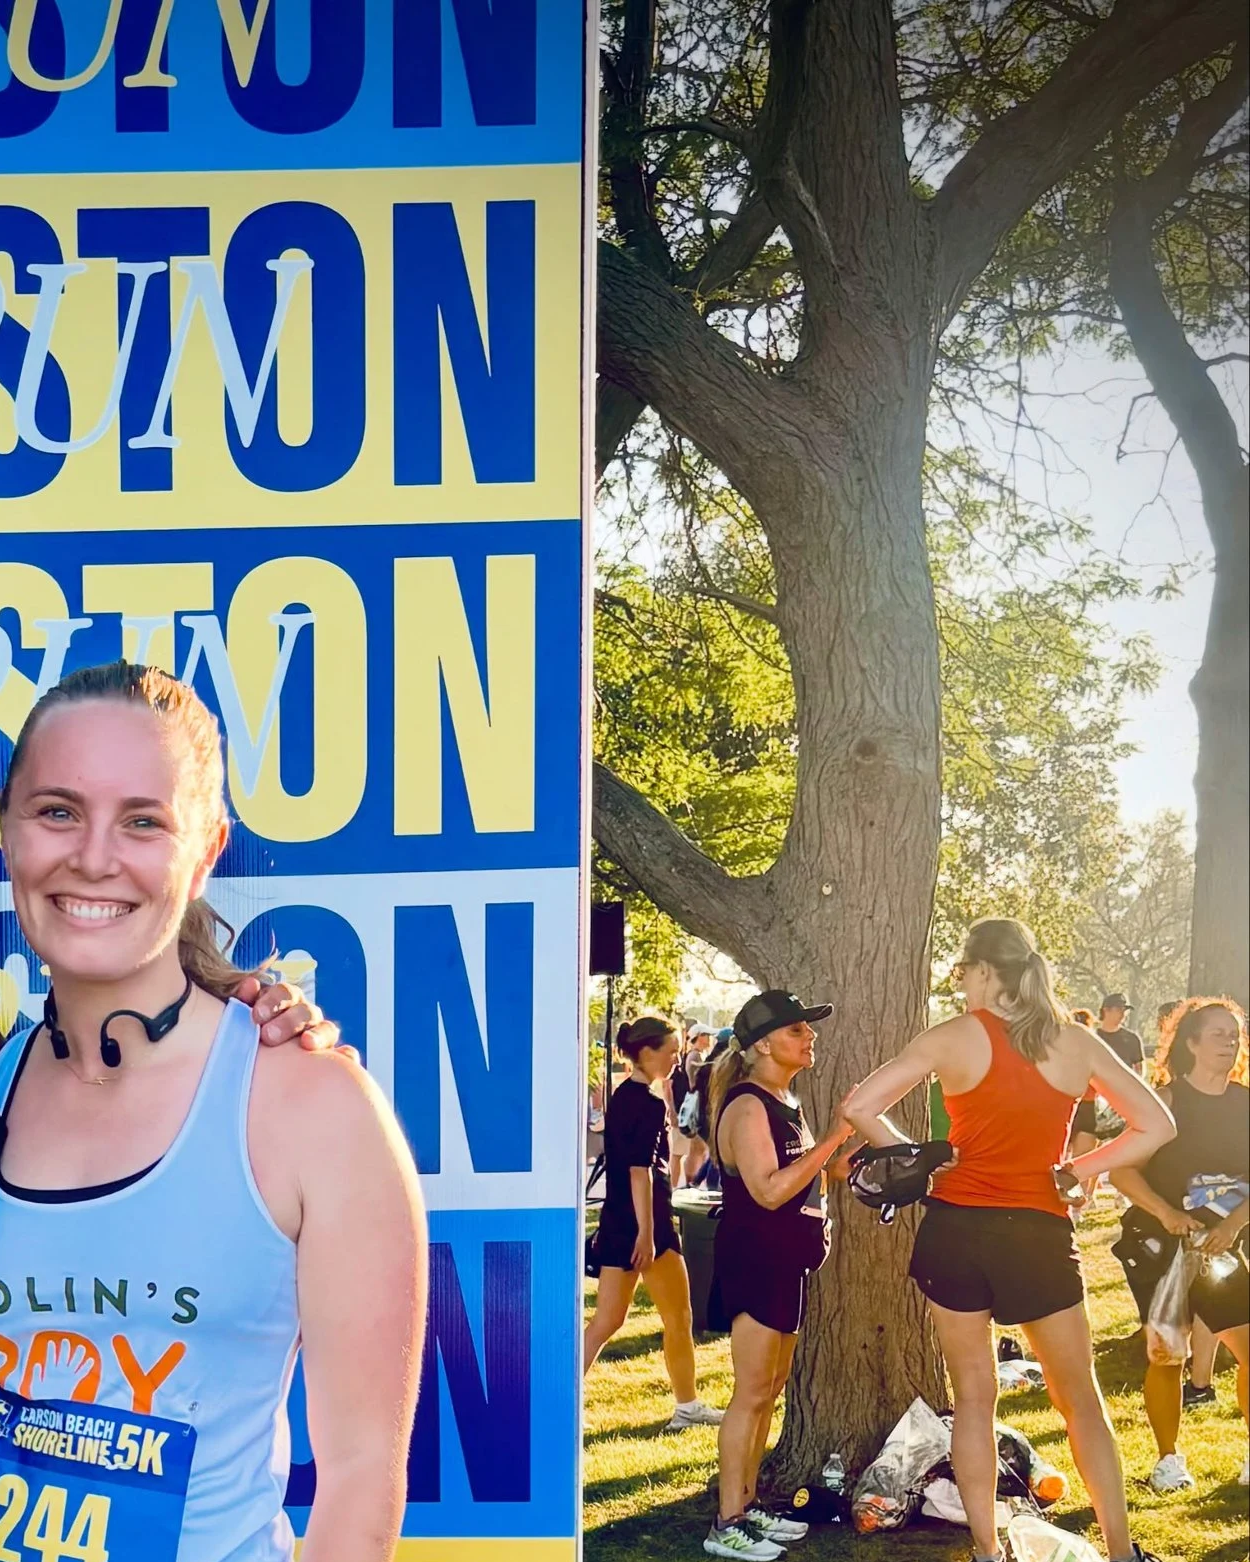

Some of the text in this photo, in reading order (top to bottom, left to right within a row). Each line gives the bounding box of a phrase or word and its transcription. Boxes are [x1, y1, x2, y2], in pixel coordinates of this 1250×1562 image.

[11, 1422, 113, 1467] SHORELINE
[20, 1406, 64, 1431] CARSON
[64, 1413, 116, 1440] BEACH
[113, 1423, 171, 1477] 5K
